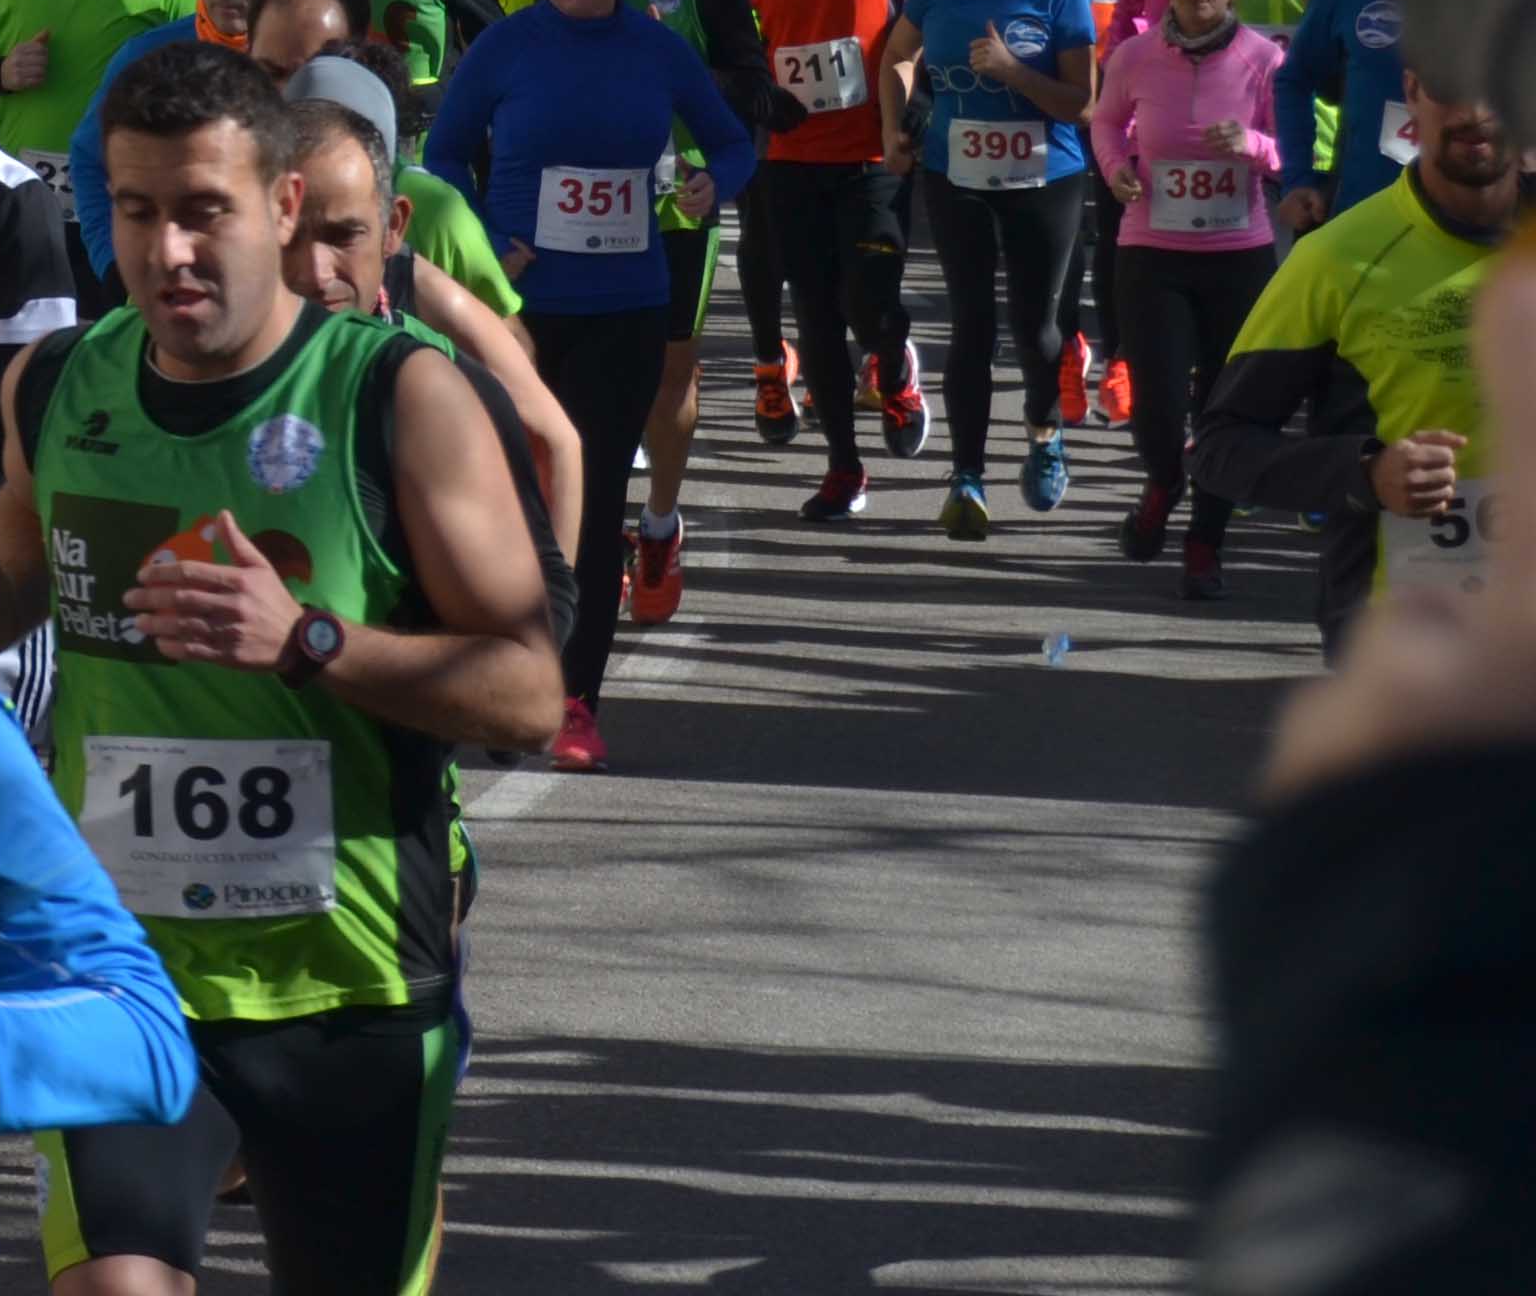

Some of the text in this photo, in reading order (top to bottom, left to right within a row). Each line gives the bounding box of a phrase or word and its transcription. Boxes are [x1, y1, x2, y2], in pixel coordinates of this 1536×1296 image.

[784, 49, 846, 84] 211
[962, 129, 1033, 161] 390
[557, 177, 632, 216] 351
[1167, 167, 1237, 200] 384
[52, 528, 88, 569] Na
[55, 563, 96, 603] tur
[119, 763, 295, 841] 168
[224, 882, 311, 903] Pinocio
